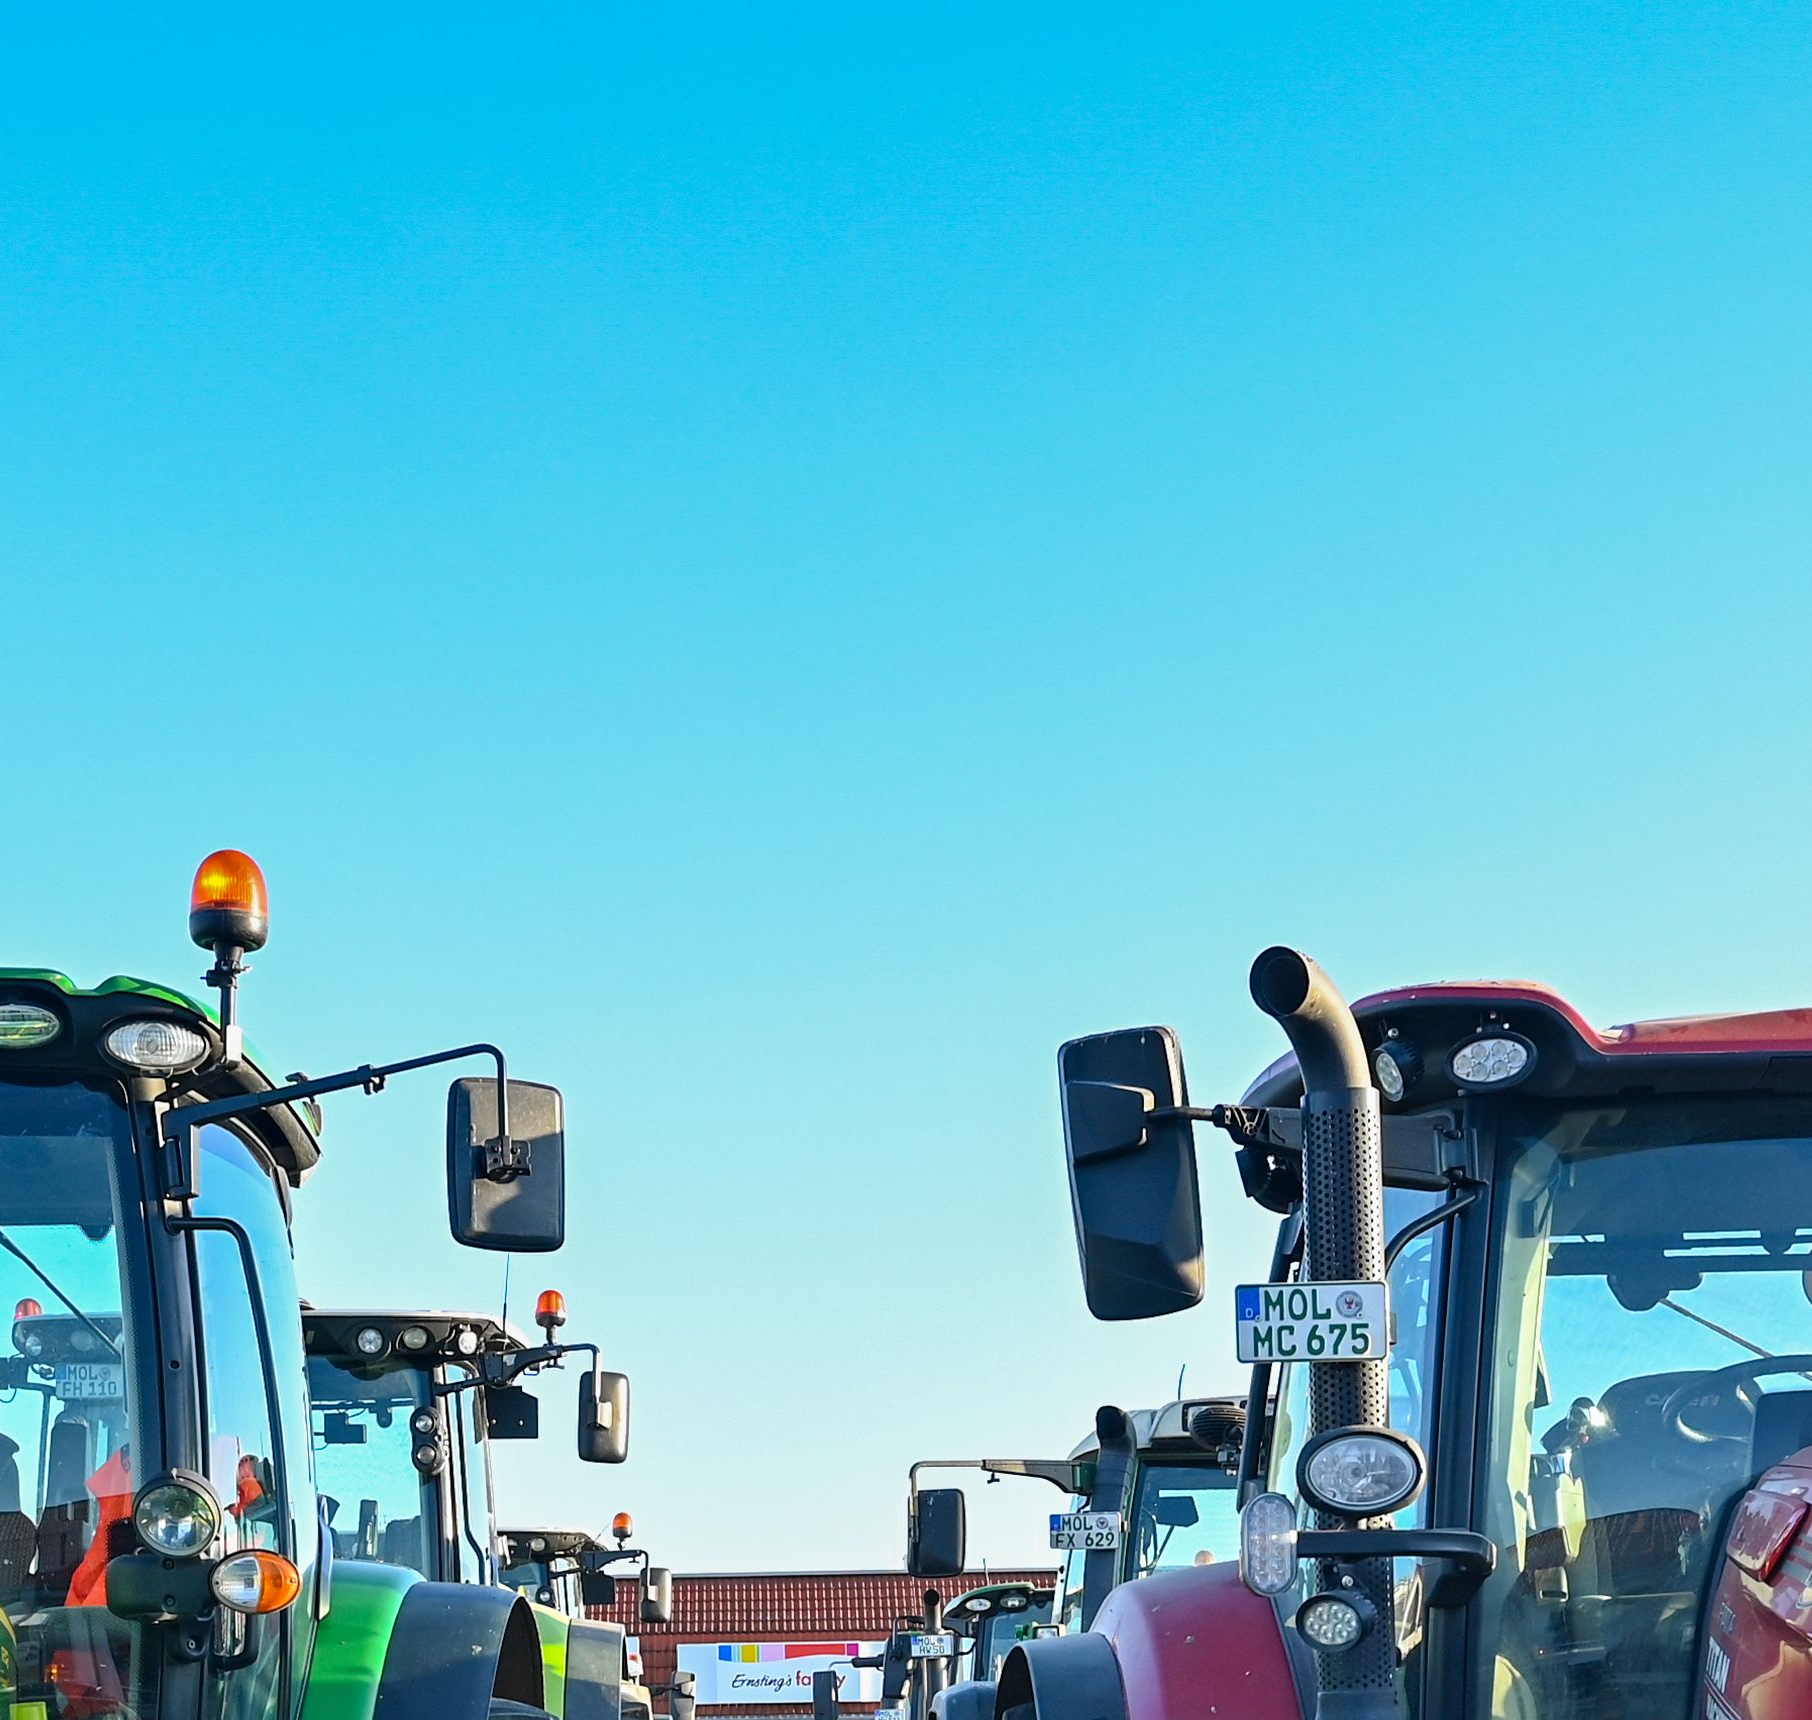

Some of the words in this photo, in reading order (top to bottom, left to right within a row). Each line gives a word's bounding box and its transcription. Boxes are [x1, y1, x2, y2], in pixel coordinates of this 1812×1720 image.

[1264, 1288, 1331, 1322] MOL
[1253, 1325, 1297, 1357] MC
[1307, 1323, 1370, 1355] 675
[67, 1365, 98, 1380] MOL
[62, 1381, 82, 1396] FH
[88, 1381, 117, 1396] 110
[1061, 1516, 1094, 1532] MOL
[1055, 1533, 1076, 1548] FX
[1085, 1532, 1115, 1547] 629
[731, 1673, 792, 1693] Ernsting's
[796, 1669, 846, 1688] fay
